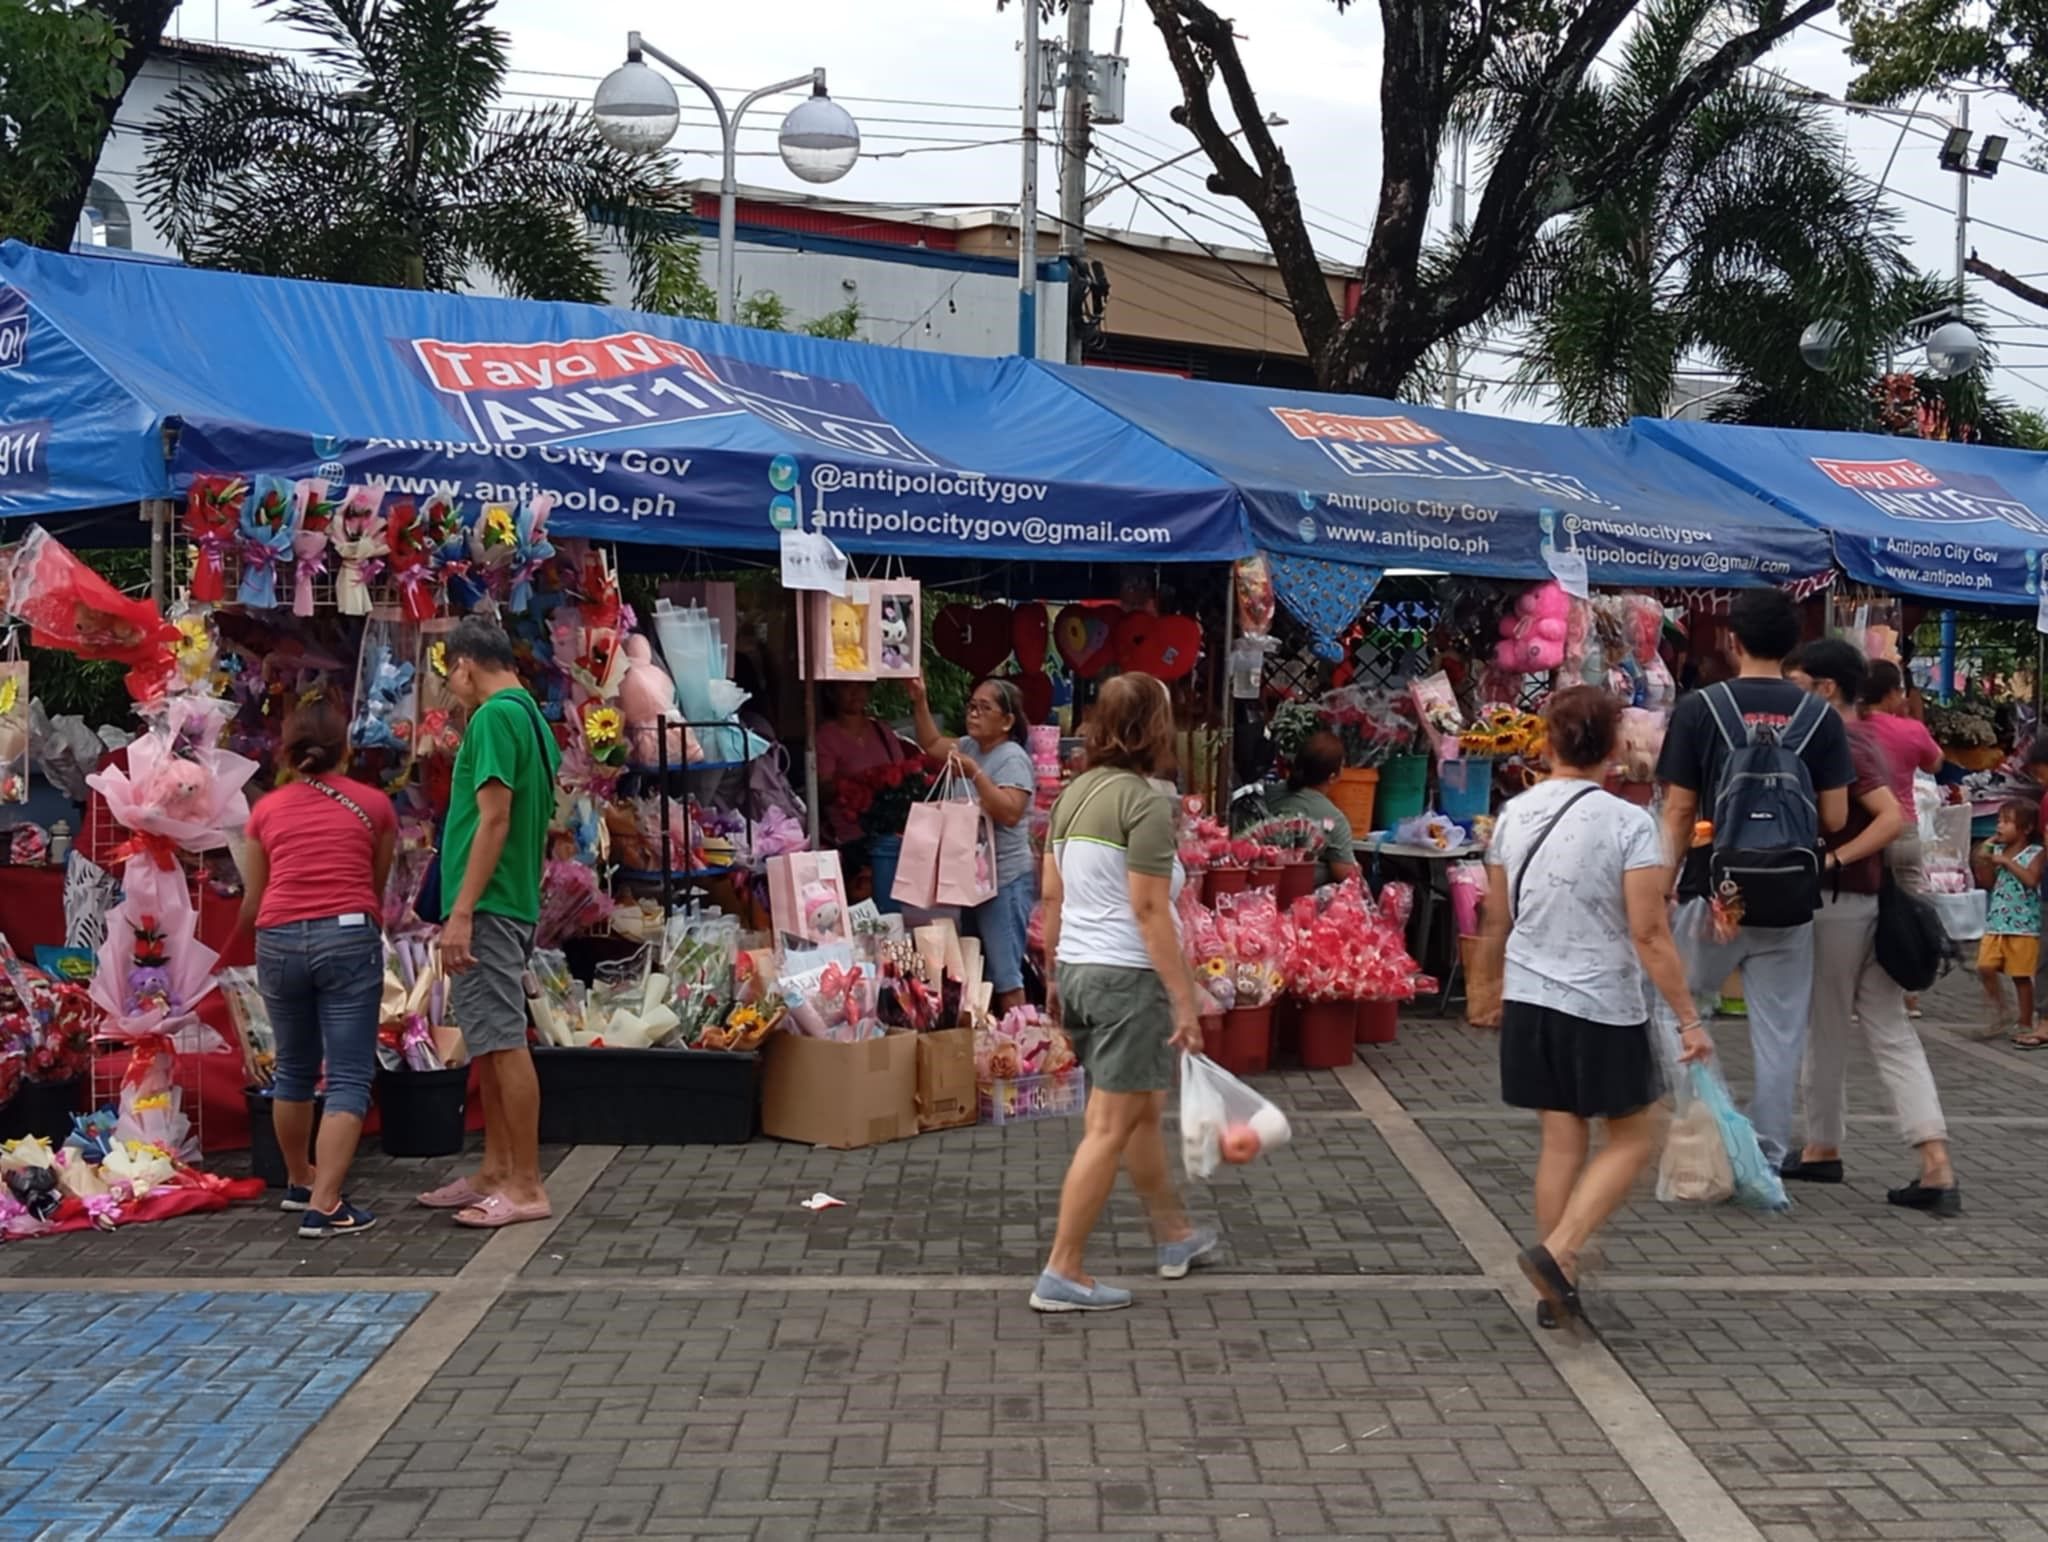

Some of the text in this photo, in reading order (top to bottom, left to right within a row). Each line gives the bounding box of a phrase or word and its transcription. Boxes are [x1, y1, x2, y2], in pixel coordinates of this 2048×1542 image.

[432, 347, 598, 390] Tayo
[1285, 411, 1382, 443] Tayo
[620, 449, 693, 477] Gov
[1823, 463, 1898, 490] Tayo
[365, 472, 677, 520] www.antipolo.ph
[811, 463, 1048, 503] @antipolocitygov
[1325, 491, 1500, 523] Antipolo City Gov
[811, 506, 1172, 545] antipolocitygov@gmail.com
[1326, 523, 1490, 556] www.antipolo.ph
[1562, 512, 1713, 545] @antipolocitygov
[1886, 536, 1999, 564] Antipolo City Gov
[1885, 564, 1993, 591] www.antipolo.ph
